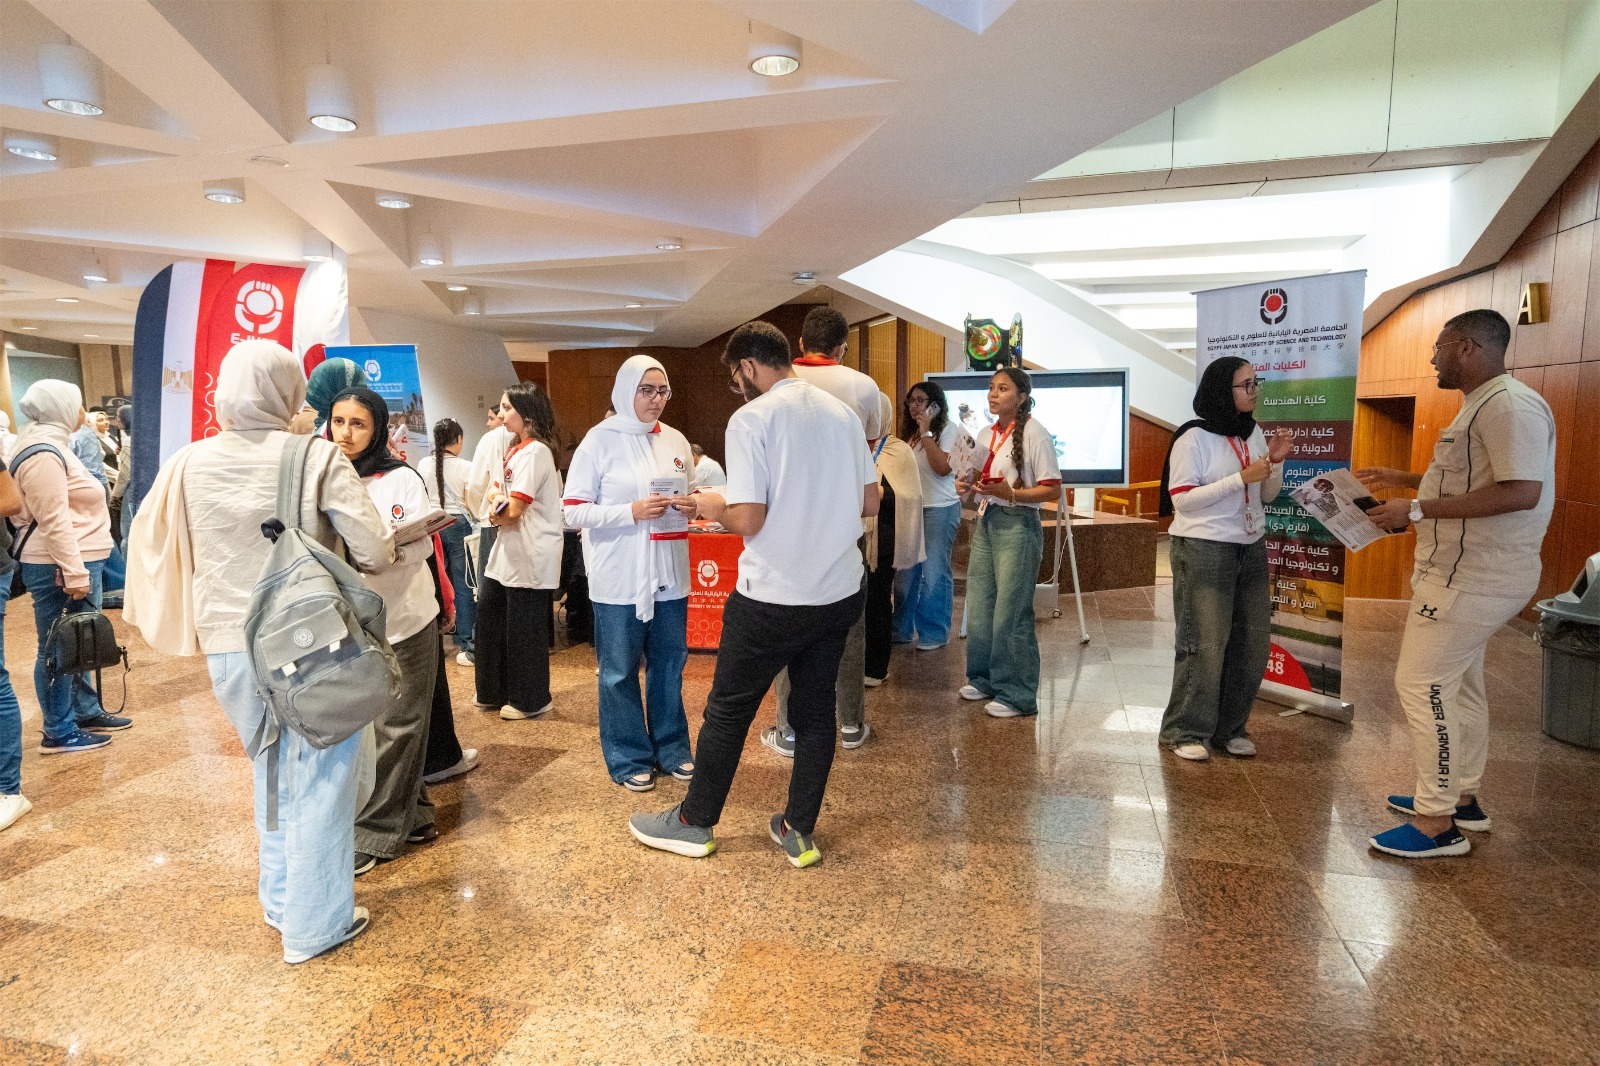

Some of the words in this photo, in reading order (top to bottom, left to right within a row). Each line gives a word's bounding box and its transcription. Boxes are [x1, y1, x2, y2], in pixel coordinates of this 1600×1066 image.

[1292, 326, 1319, 336] المصرية
[1320, 323, 1348, 333] الجامعة
[1207, 334, 1240, 344] التكنولوجيا
[1207, 343, 1239, 351] EGYPT-JAPAN
[1239, 340, 1267, 349] UNIVERSITY
[1310, 333, 1347, 342] TECHNOLOGY
[1246, 331, 1267, 341] للعلوم
[1273, 360, 1306, 372] الكليات
[1263, 395, 1302, 406] الهندسة
[1304, 395, 1326, 407] كلية
[1310, 427, 1335, 439] كلية
[1301, 443, 1335, 456] الدولية
[1284, 467, 1314, 479] العلوم
[1263, 505, 1294, 517] الصيدلة
[1265, 540, 1280, 550] الحا
[1282, 543, 1306, 555] علوم
[1307, 545, 1329, 557] كلية
[1285, 557, 1330, 572] تكنولوجيا
[1332, 565, 1339, 576] و
[1276, 580, 1297, 591] كلية
[1269, 595, 1289, 604] التص
[1290, 599, 1297, 608] و
[1299, 599, 1317, 609] الفن
[1429, 684, 1445, 721] UNDER
[1435, 723, 1450, 775] ARMOUR
